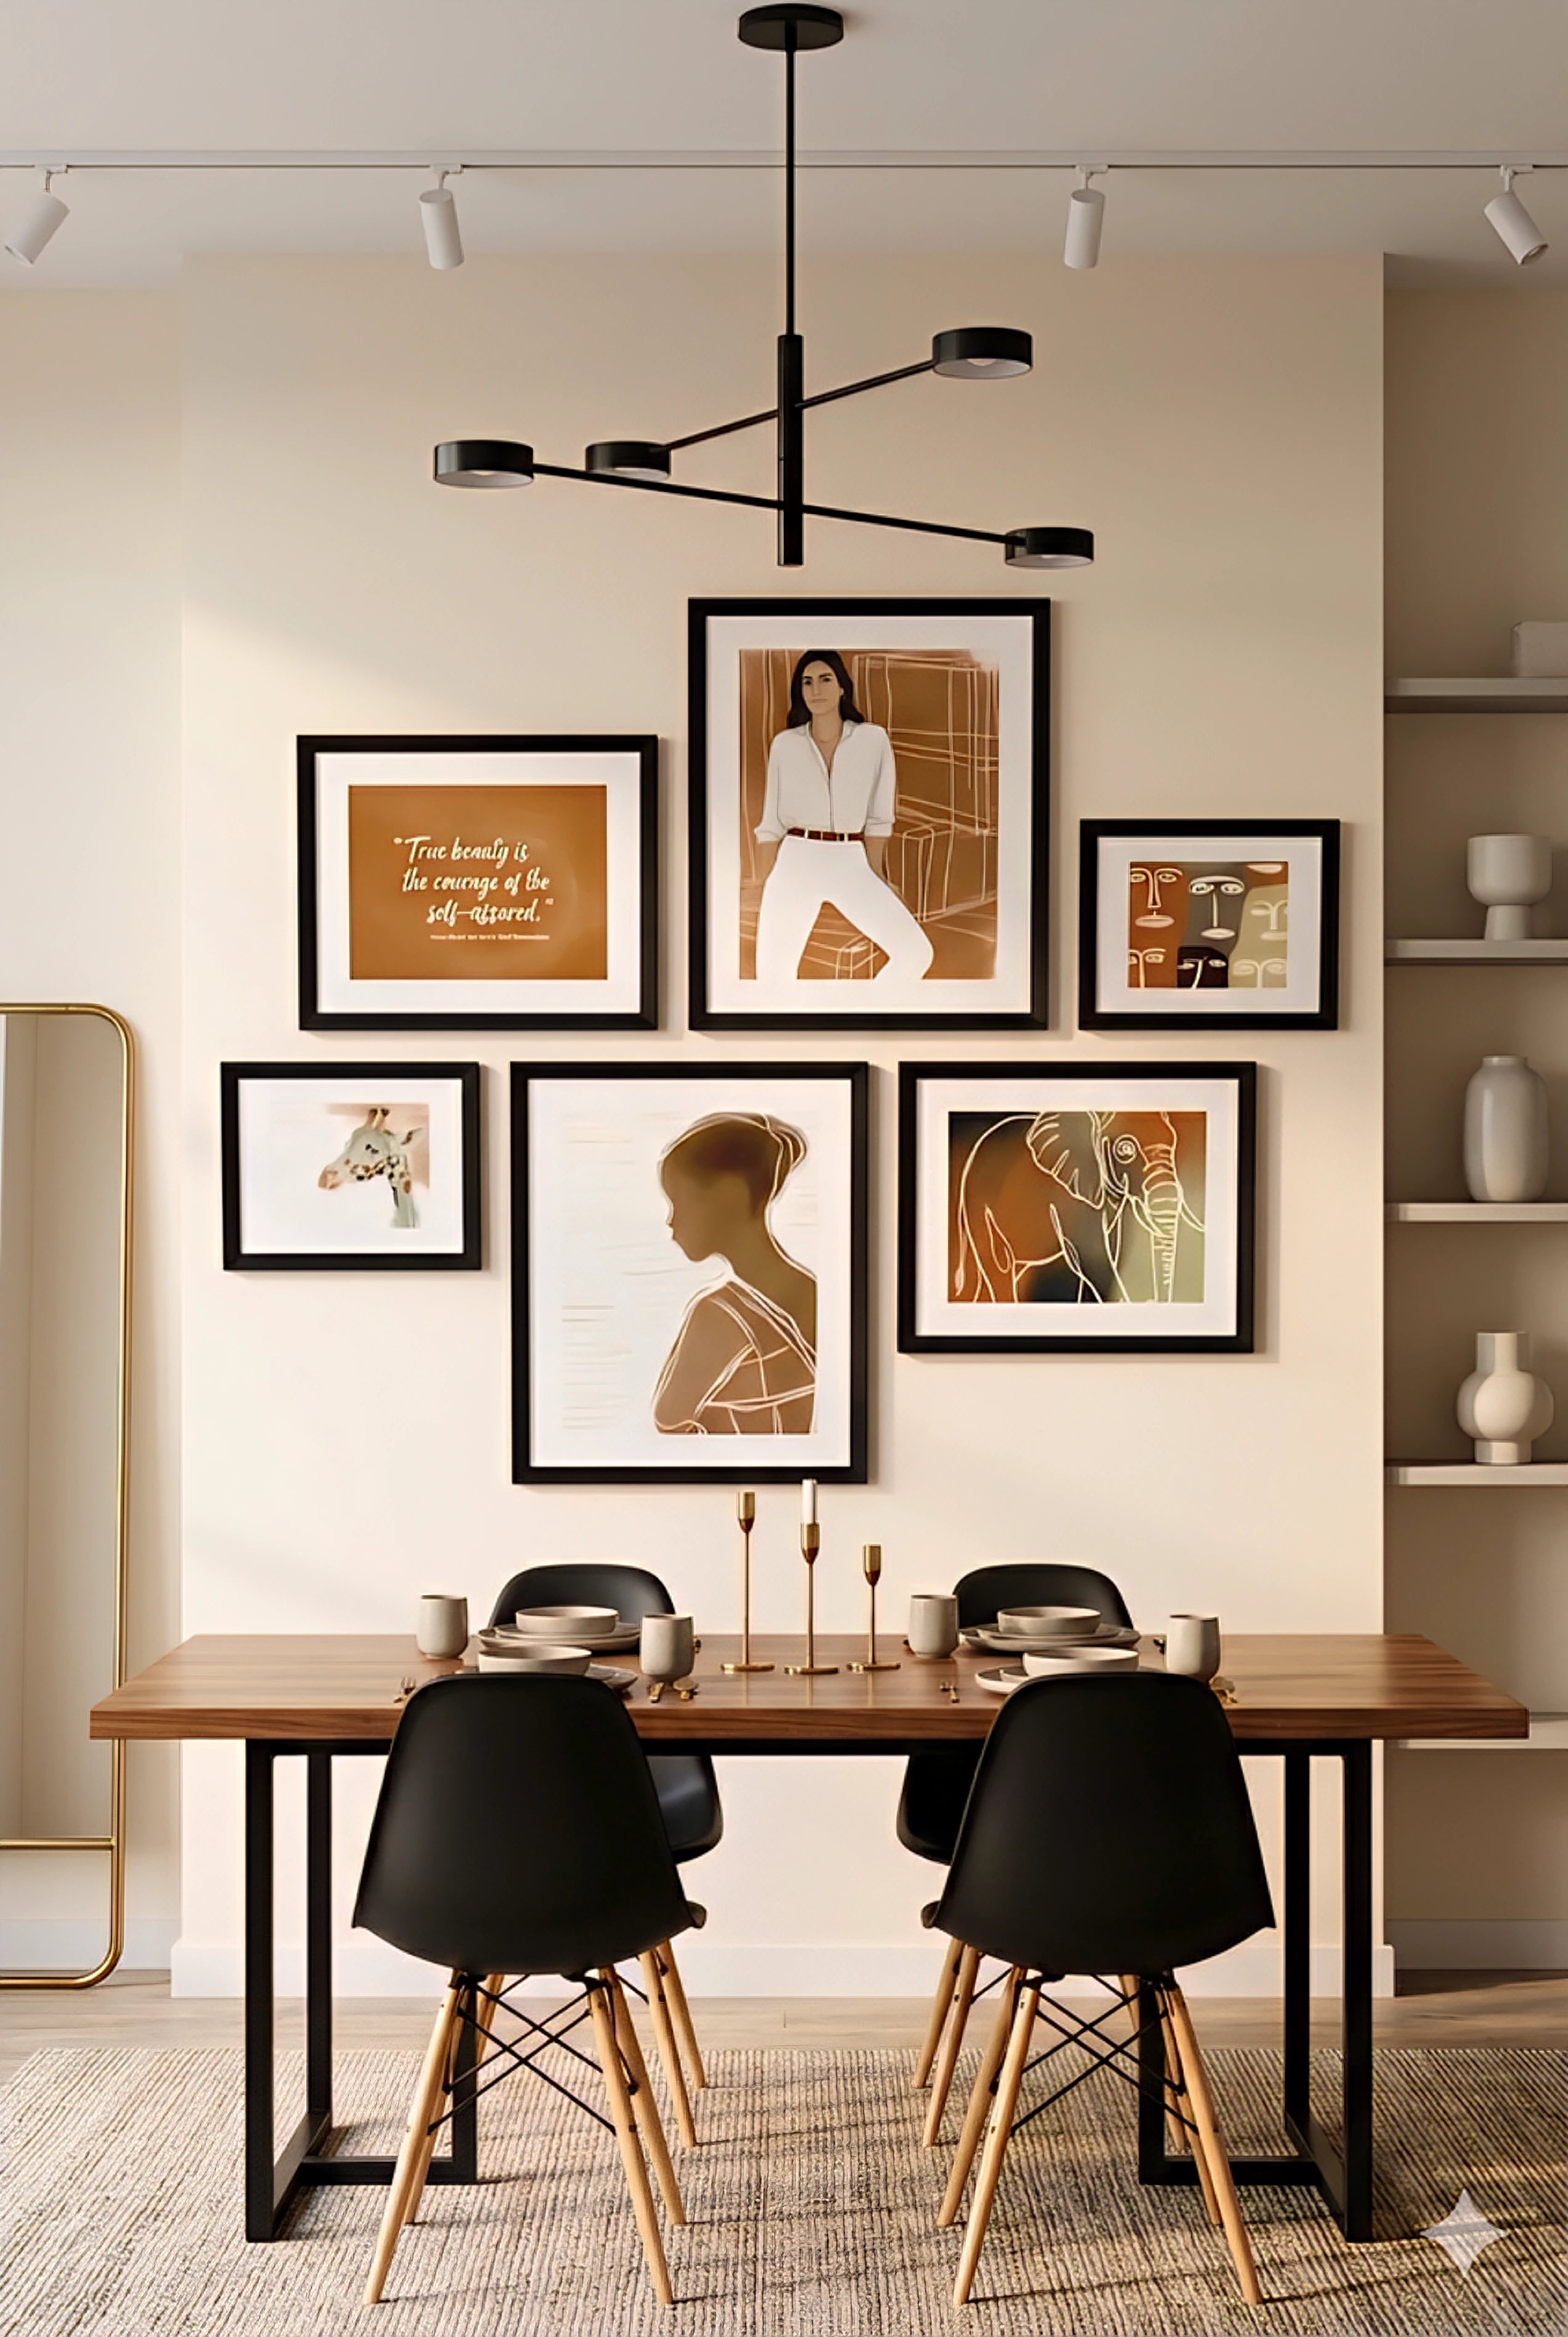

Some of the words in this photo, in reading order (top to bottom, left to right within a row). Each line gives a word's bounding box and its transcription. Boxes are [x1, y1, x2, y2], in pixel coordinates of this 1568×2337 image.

[513, 841, 529, 862] is
[402, 867, 428, 892] the
[504, 871, 523, 896] of
[525, 866, 550, 891] the
